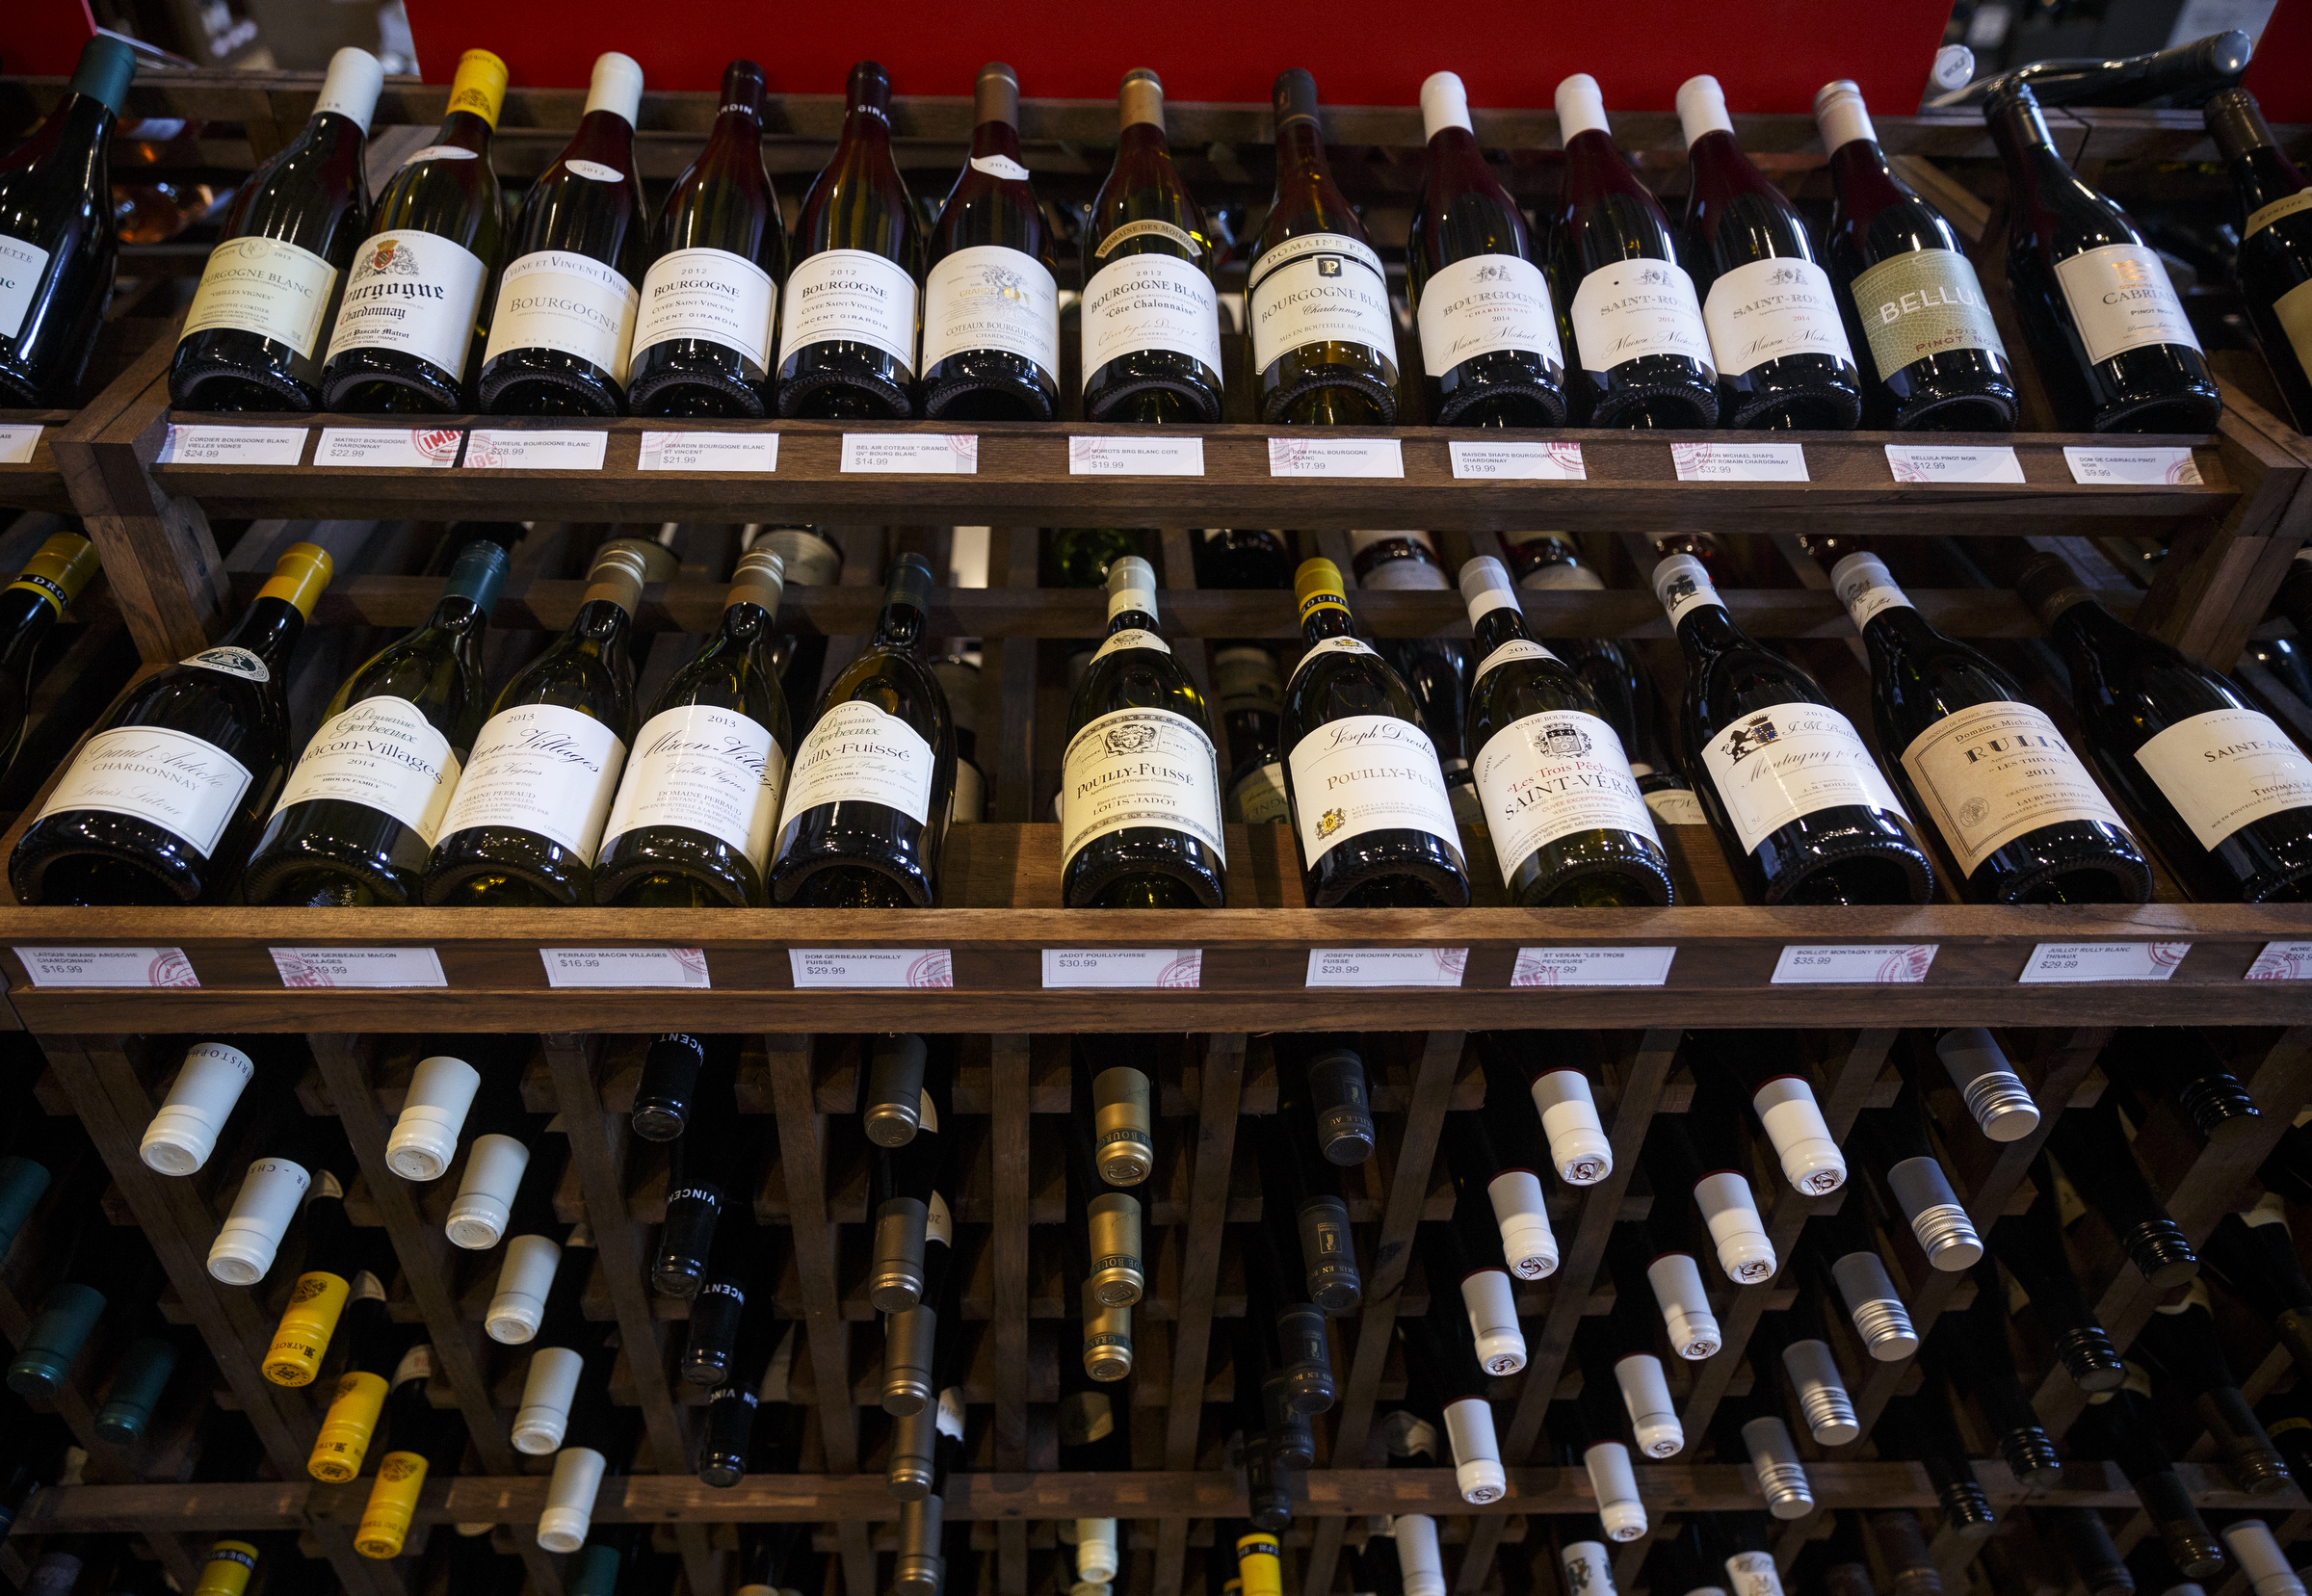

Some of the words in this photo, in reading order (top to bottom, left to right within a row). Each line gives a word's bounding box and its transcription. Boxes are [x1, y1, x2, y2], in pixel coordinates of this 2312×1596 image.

[1100, 225, 1139, 254] DOMAINE
[1141, 223, 1159, 232] DES
[1160, 225, 1198, 253] MOIROTS
[1266, 237, 1343, 265] DOMAINE
[269, 272, 314, 298] BLANC
[550, 256, 600, 277] VINCENT
[601, 270, 639, 306] DUREUIL
[341, 282, 445, 308] Bourgogne
[653, 280, 741, 299] BOURGOGNE
[801, 281, 888, 300] BOURGOGNE
[959, 287, 996, 298] GRANDE
[1090, 279, 1170, 315] BOURGOGNE
[1173, 281, 1211, 311] BLANC
[674, 300, 736, 314] SAINT-VINCENT
[825, 301, 884, 316] SAINT-VINCENT
[1133, 299, 1197, 317] Chalonnaise"
[1261, 287, 1356, 324] BOURGOGNE
[1301, 303, 1364, 319] Chardonnay
[1443, 291, 1546, 318] BOURGOGNE
[339, 306, 407, 327] Chardonnay
[509, 297, 619, 336] BOURGOGNE
[645, 313, 684, 329] VINCENT
[688, 312, 739, 329] GIRARDIN
[796, 313, 835, 329] VINCENT
[840, 314, 888, 330] GIRARDIN
[354, 327, 381, 337] Pascale
[381, 327, 410, 339] Matrot
[1304, 322, 1347, 336] BOUTEILLE
[1484, 326, 1537, 342] Michael
[945, 322, 985, 337] COTEAUX
[986, 322, 1051, 354] BOURGUIGNONS
[975, 332, 1027, 346] CHARDONNAY
[1915, 336, 1963, 353] PINOT
[184, 449, 220, 458] $24.99
[329, 449, 365, 458] $22.99
[663, 456, 696, 464] $21.99
[855, 457, 888, 466] $14.99
[1091, 460, 1124, 469] $19.99
[1293, 461, 1326, 470] $17.99
[1463, 464, 1496, 473] $19.99
[1913, 461, 1946, 470] $12.99
[1507, 645, 1537, 656] 2013
[352, 706, 416, 730] Domaine
[507, 713, 535, 724] 2013
[834, 705, 859, 716] 2014
[1803, 709, 1831, 719] 2013
[707, 715, 737, 728] 2013
[819, 717, 877, 733] Domaine
[1543, 715, 1595, 724] BOURGOGNE
[1926, 723, 1949, 742] PRODUIT
[1957, 711, 1982, 724] FRANCE
[328, 716, 419, 745] Gerbeaux
[1954, 721, 1998, 744] Domaine
[2000, 719, 2034, 727] Michel
[805, 726, 882, 757] Gerbeaux
[1324, 723, 1379, 752] Joseph
[1381, 722, 1437, 761] Drouhin
[1963, 734, 2070, 766] RULLY
[84, 736, 161, 765] Grand
[146, 751, 230, 789] Ardèche
[299, 740, 444, 786] Mâcon-Villages
[347, 758, 377, 769] 2014
[630, 729, 778, 802] Mâcon-Villages
[1482, 754, 1493, 783] ESTATE
[1742, 749, 1831, 789] Montagny
[2021, 757, 2068, 766] THIVAUX
[92, 763, 199, 792] CHARDONNAY
[1536, 763, 1573, 780] Trois
[2025, 769, 2058, 778] 2011
[710, 767, 747, 793] Vignes
[1076, 763, 1195, 801] POUILLY-FUISSÉ
[1090, 781, 1123, 798] Appellation
[1123, 777, 1150, 786] d'Origine
[493, 791, 537, 800] PERRAUD
[1505, 772, 1646, 821] SAINT-VÉRAN
[2250, 783, 2299, 798] THOMAS
[121, 785, 183, 816] Latour
[657, 790, 703, 801] DOMAINE
[704, 794, 742, 817] PERRAUD
[1092, 798, 1131, 817] LOUIS
[1133, 797, 1178, 808] JADOT
[1541, 801, 1566, 813] CUVÉE
[2017, 794, 2058, 807] LAURENT
[2229, 800, 2262, 817] BOUTEILLE
[1551, 804, 1578, 816] WHITE
[560, 959, 600, 968] $16.99
[1059, 959, 1097, 968] $30.99
[1793, 956, 1831, 965] $35.99
[2040, 960, 2079, 969] $29.99
[41, 964, 83, 974] $16.99
[307, 965, 348, 975] $19.99
[807, 966, 846, 975] $29.99
[1322, 965, 1360, 974] $28.99
[1538, 965, 1577, 975] $17.99
